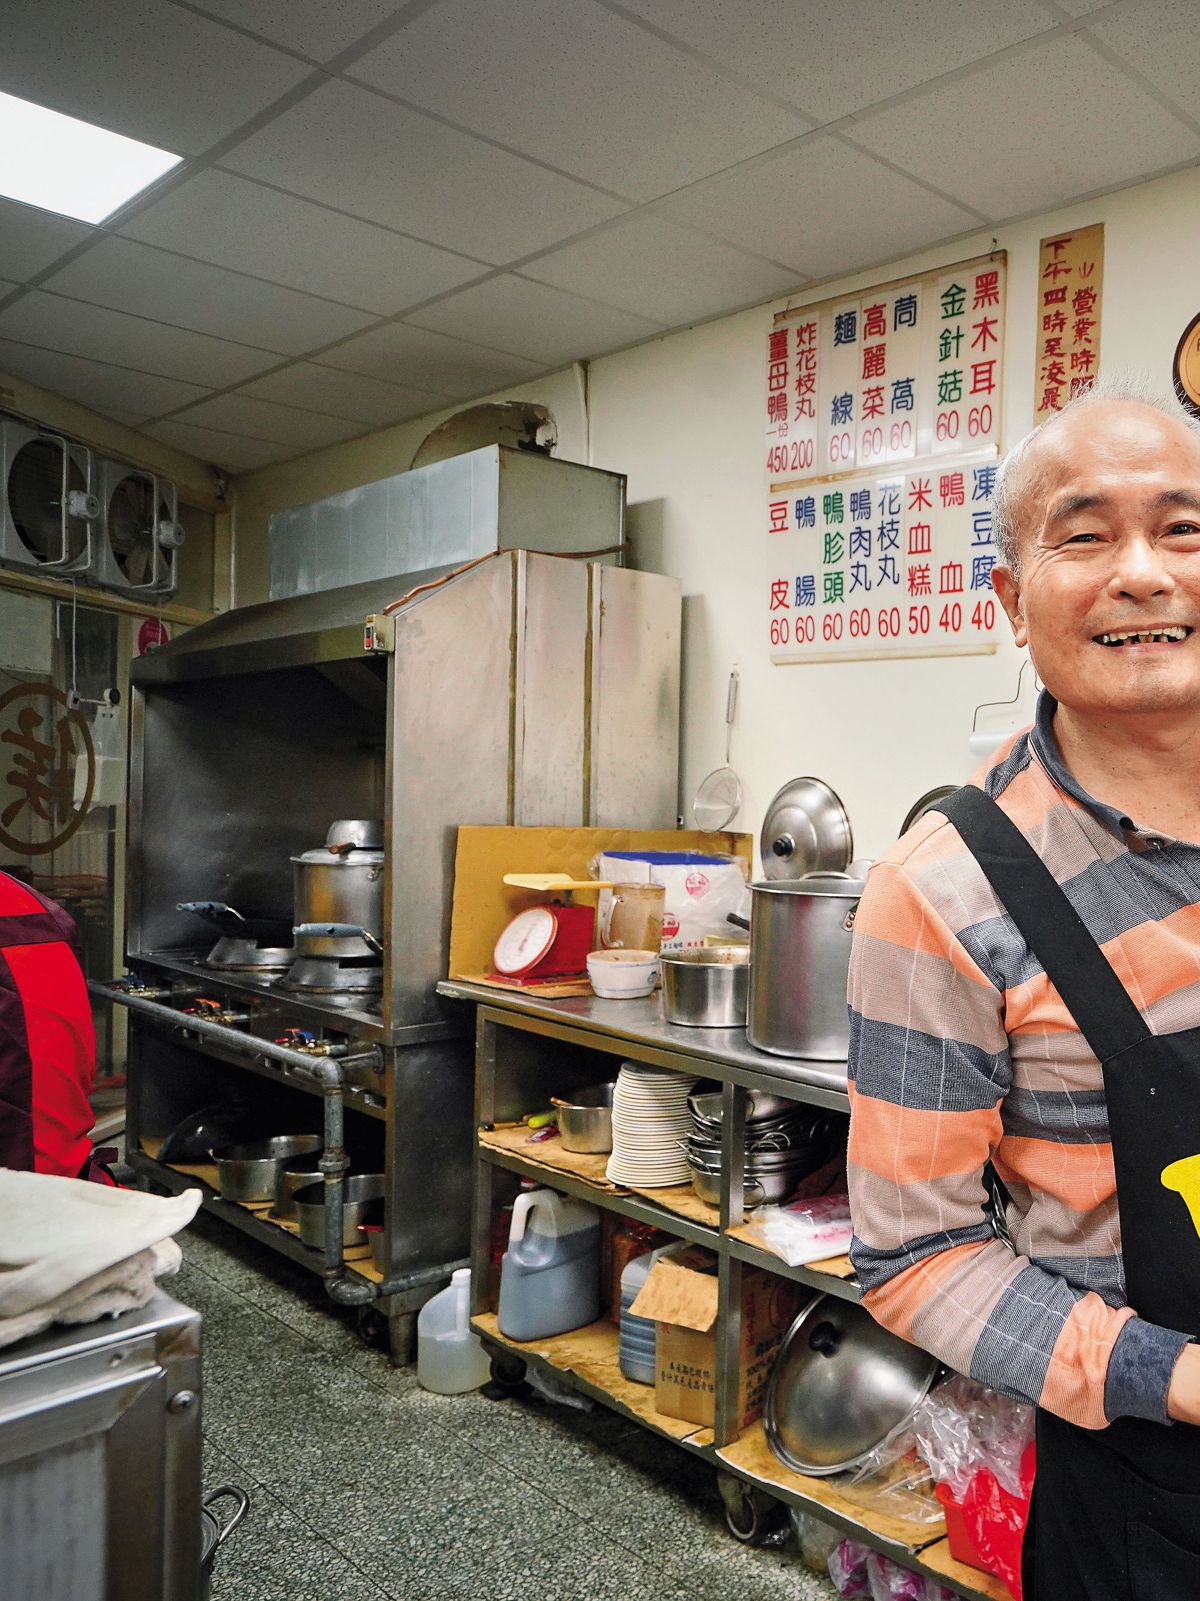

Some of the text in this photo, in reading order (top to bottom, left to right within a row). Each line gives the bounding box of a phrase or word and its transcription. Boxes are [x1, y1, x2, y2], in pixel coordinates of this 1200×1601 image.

[969, 271, 999, 395] 黑木耳
[1037, 238, 1073, 412] 下午四時至凌晨
[937, 283, 967, 406] 金針菇
[767, 328, 789, 424] 薑母鴨
[795, 322, 817, 422] 炸花枝丸
[861, 303, 887, 421] 高麗菜
[890, 420, 911, 451] 60
[936, 410, 959, 442] 60
[968, 404, 992, 437] 60
[791, 439, 813, 471] 200
[830, 432, 851, 462] 60
[862, 427, 882, 458] 60
[767, 445, 788, 473] 450
[849, 488, 872, 594] 鴨肉丸
[877, 483, 901, 587] 花枝丸
[907, 478, 933, 597] 米血糕
[795, 615, 815, 643] 60
[823, 613, 843, 641] 60
[849, 608, 871, 637] 60
[878, 607, 901, 637] 60
[908, 605, 930, 635] 50
[939, 602, 962, 633] 40
[971, 600, 995, 630] 40
[770, 618, 789, 645] 60
